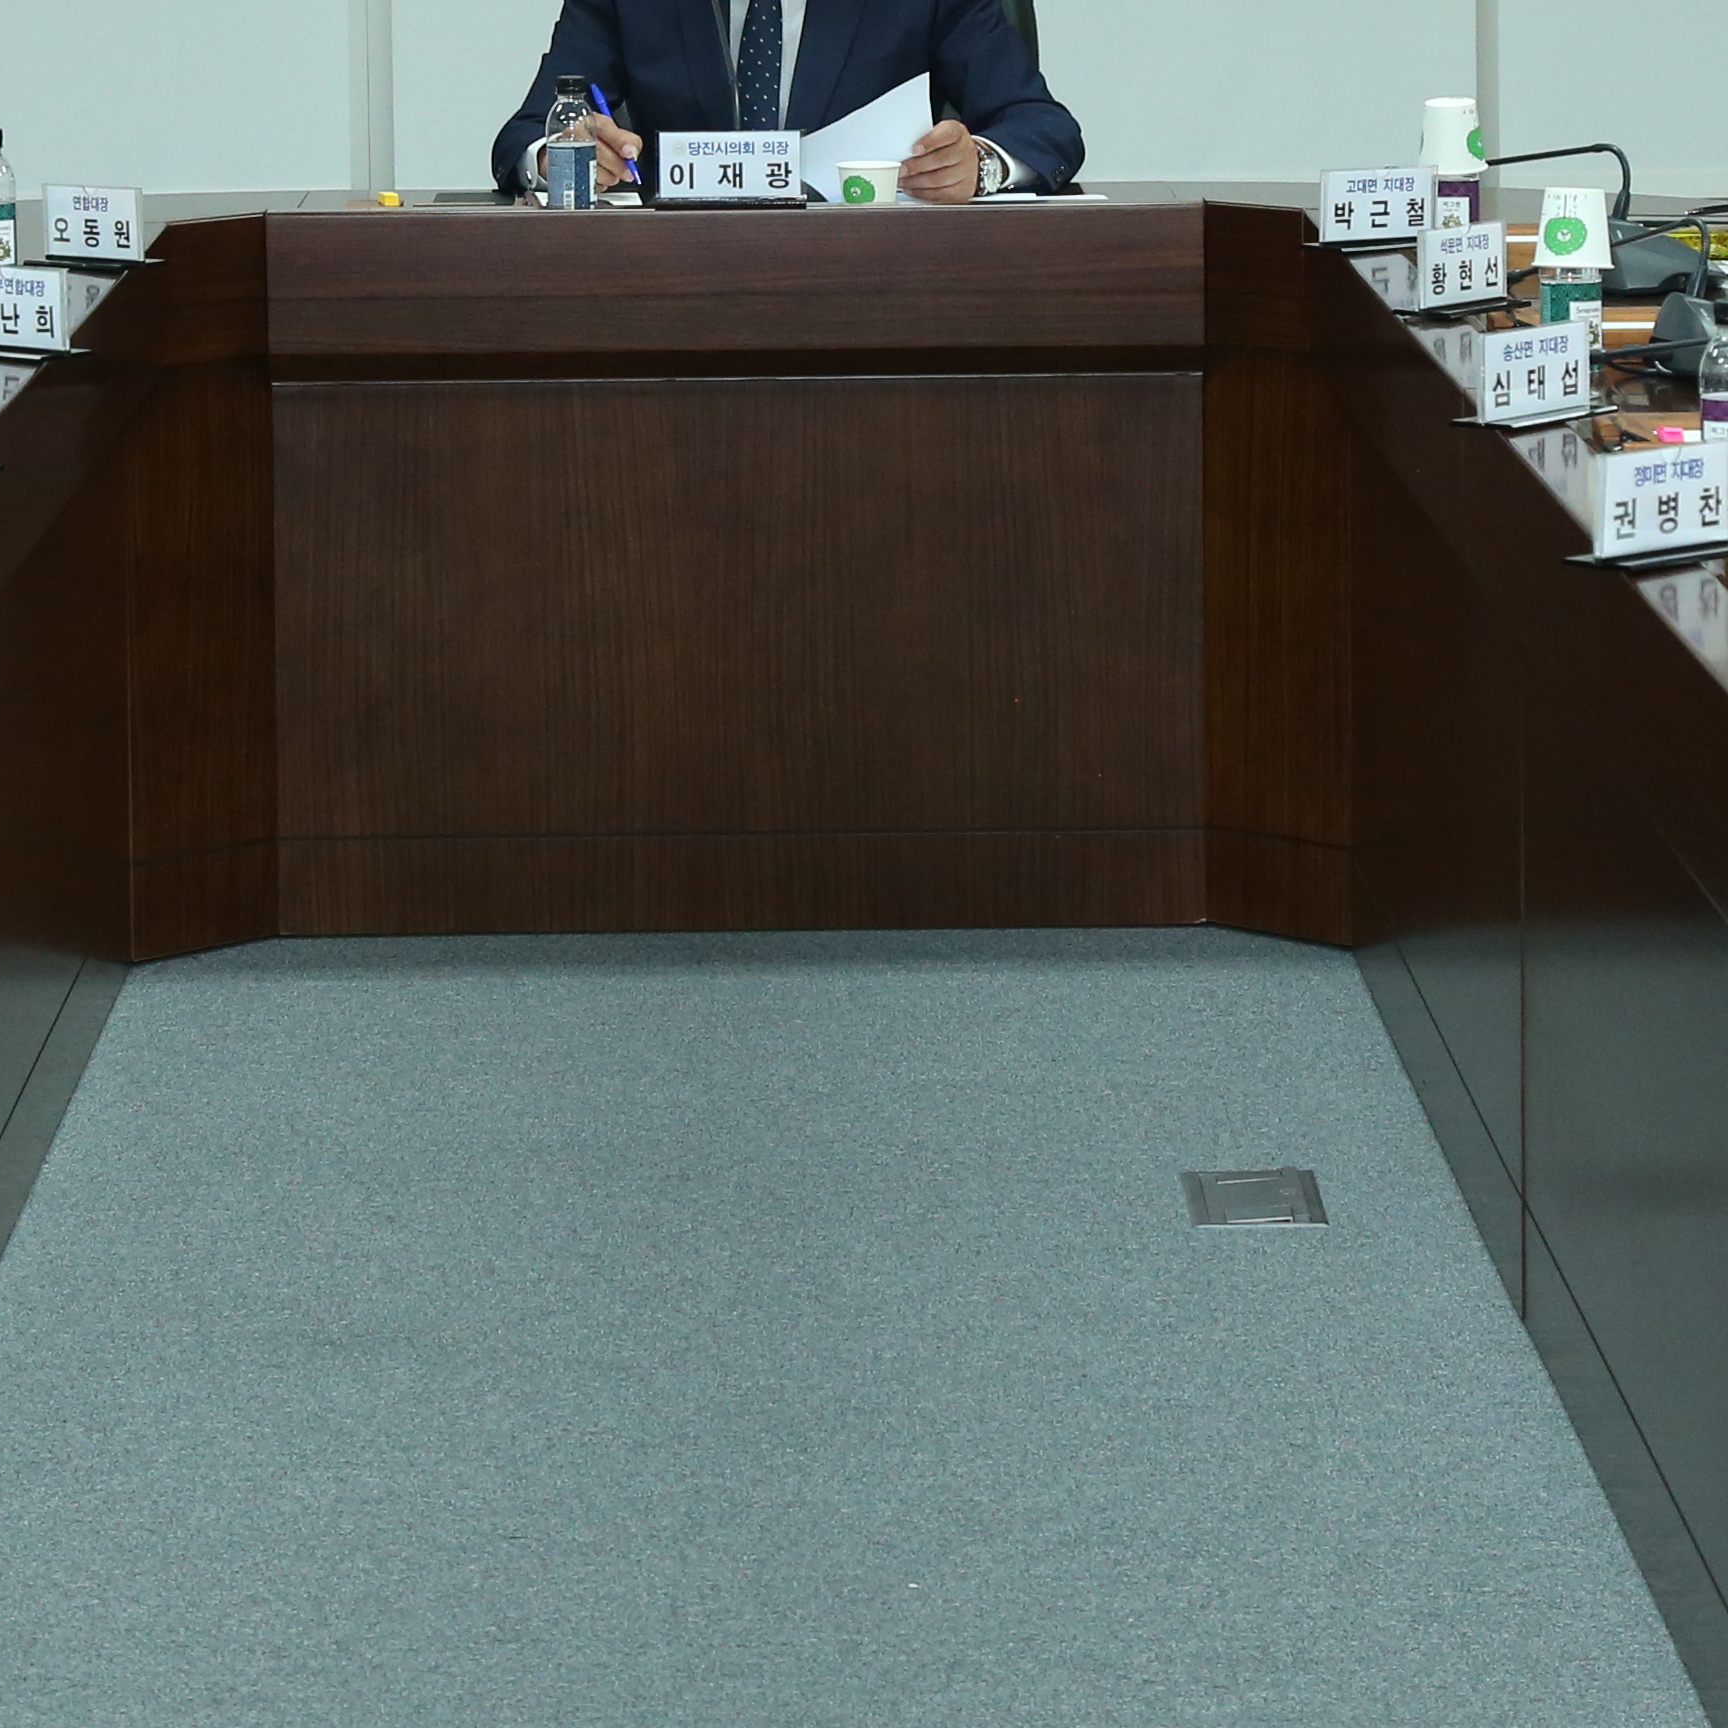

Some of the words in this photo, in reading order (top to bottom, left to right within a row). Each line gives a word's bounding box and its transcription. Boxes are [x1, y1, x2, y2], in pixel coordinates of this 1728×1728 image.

[687, 140, 756, 157] 당진시의회
[762, 140, 790, 157] 의장
[1345, 177, 1378, 194] 고대면
[1383, 176, 1415, 193] 지대장
[72, 195, 109, 213] 연합대장
[1539, 335, 1569, 356] 지대장
[1634, 462, 1667, 487] 정미면
[1671, 457, 1704, 482] 지대장
